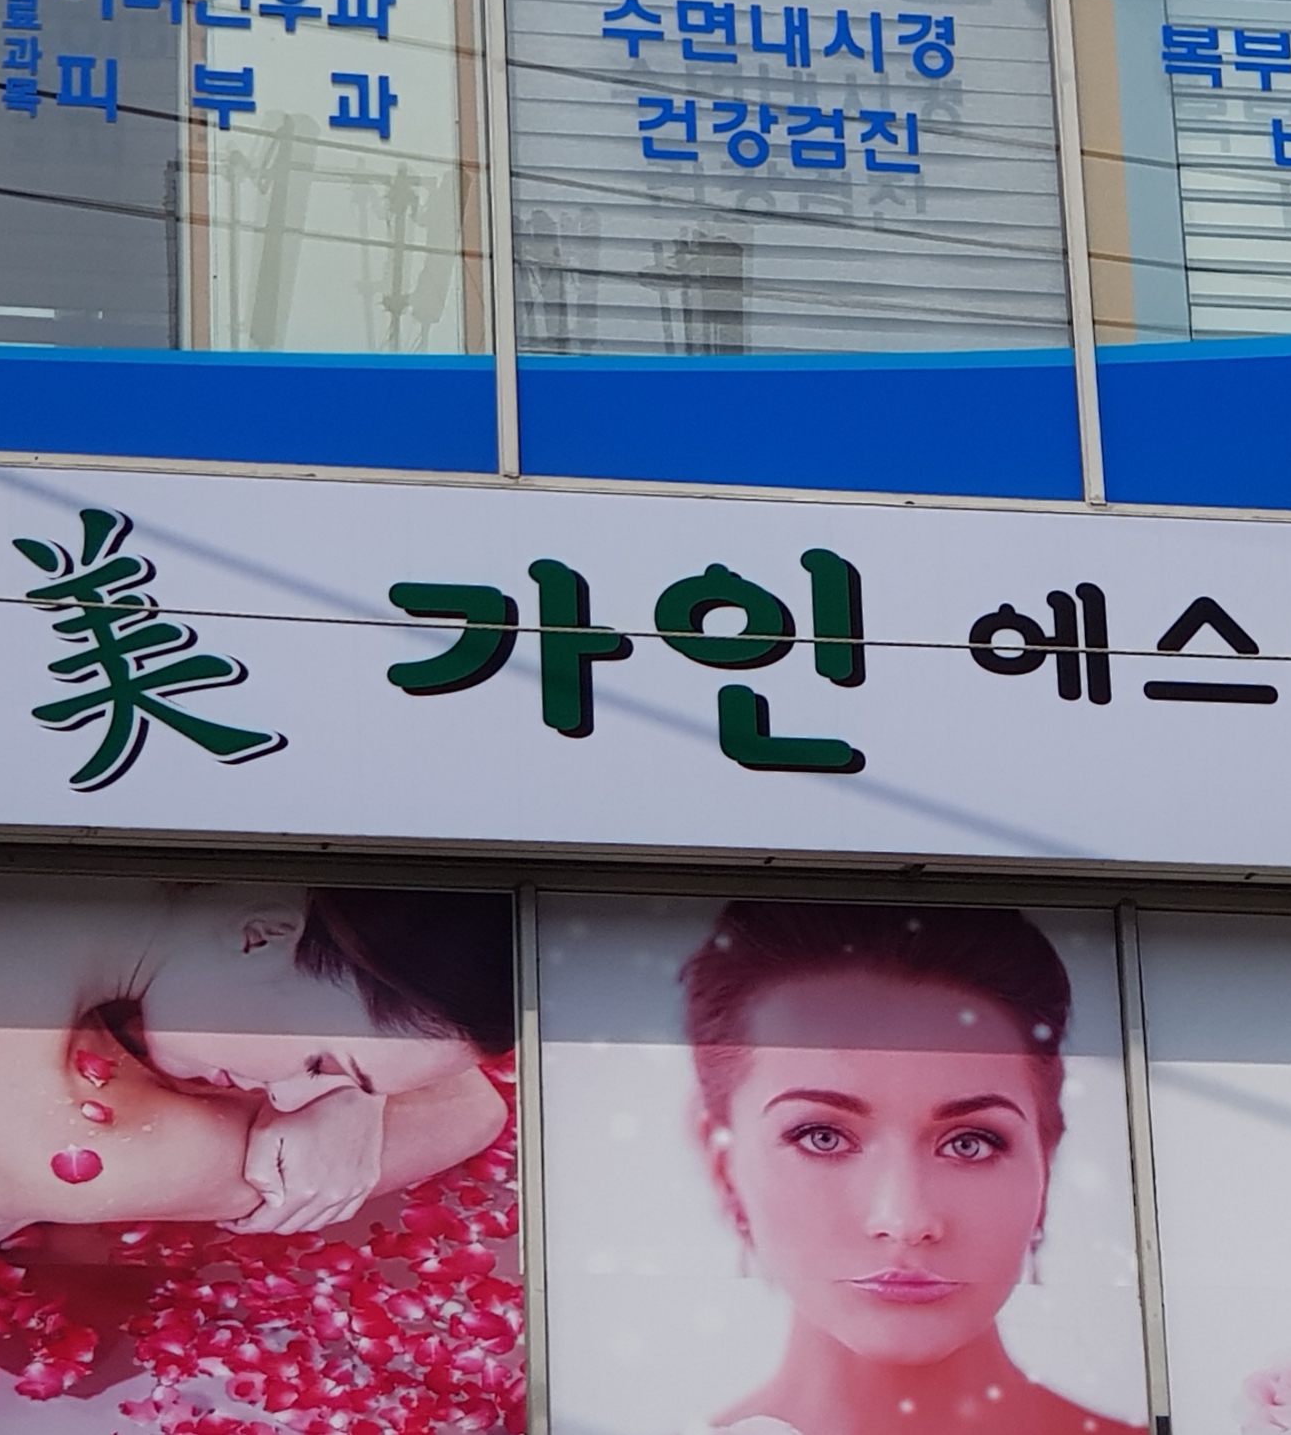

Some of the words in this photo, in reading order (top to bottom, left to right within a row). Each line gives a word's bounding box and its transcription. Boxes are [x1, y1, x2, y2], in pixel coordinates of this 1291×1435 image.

[637, 96, 921, 174] 건강검진
[11, 508, 288, 792] 美
[386, 547, 866, 773] 가인
